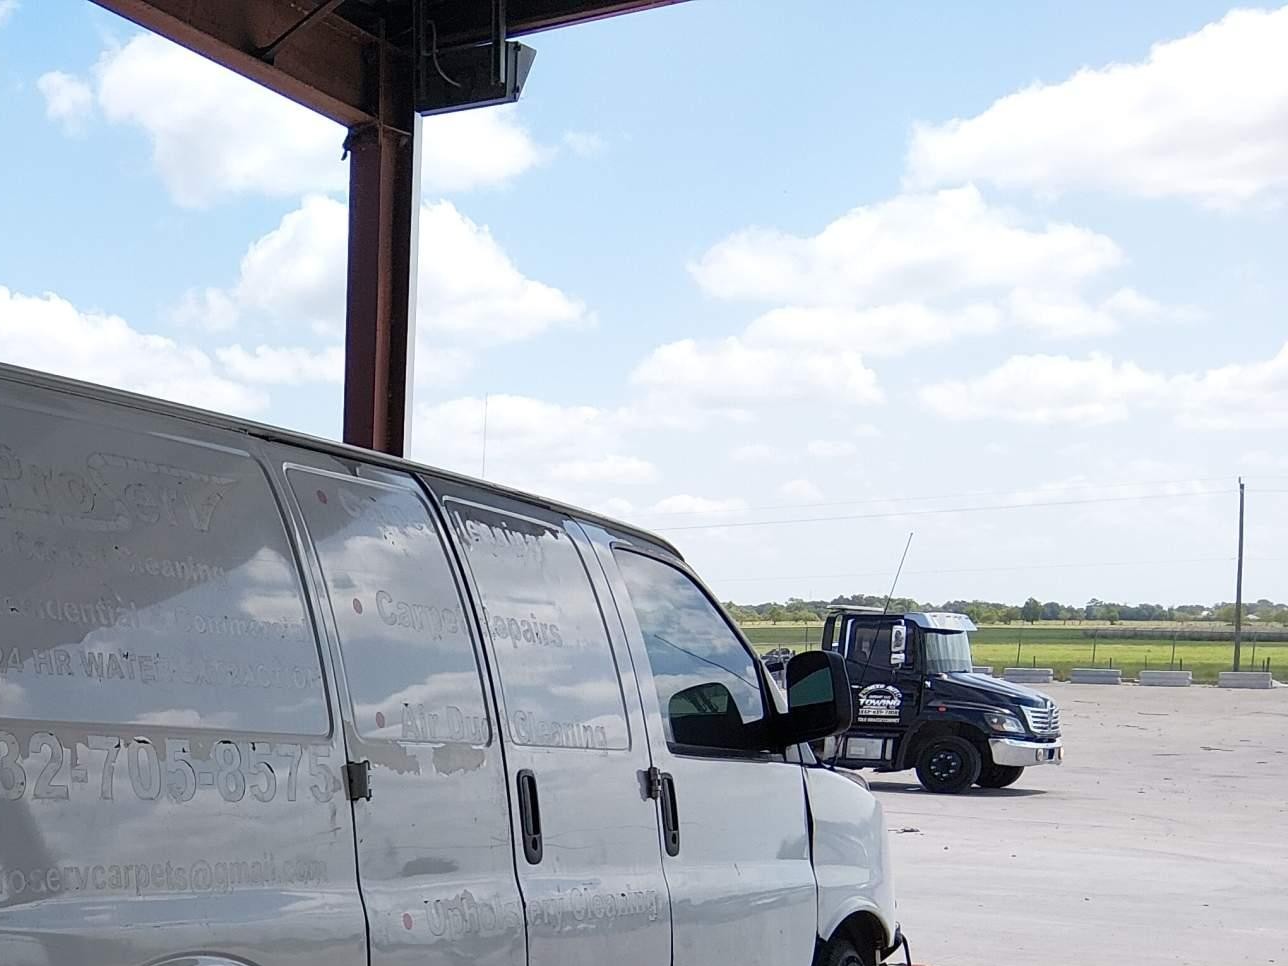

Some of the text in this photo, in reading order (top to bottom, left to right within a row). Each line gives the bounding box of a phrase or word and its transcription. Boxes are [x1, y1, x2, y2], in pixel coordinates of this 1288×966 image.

[32, 649, 75, 676] HR
[402, 702, 439, 741] Air
[512, 709, 608, 756] Cleaning
[569, 887, 661, 922] Cleaning
